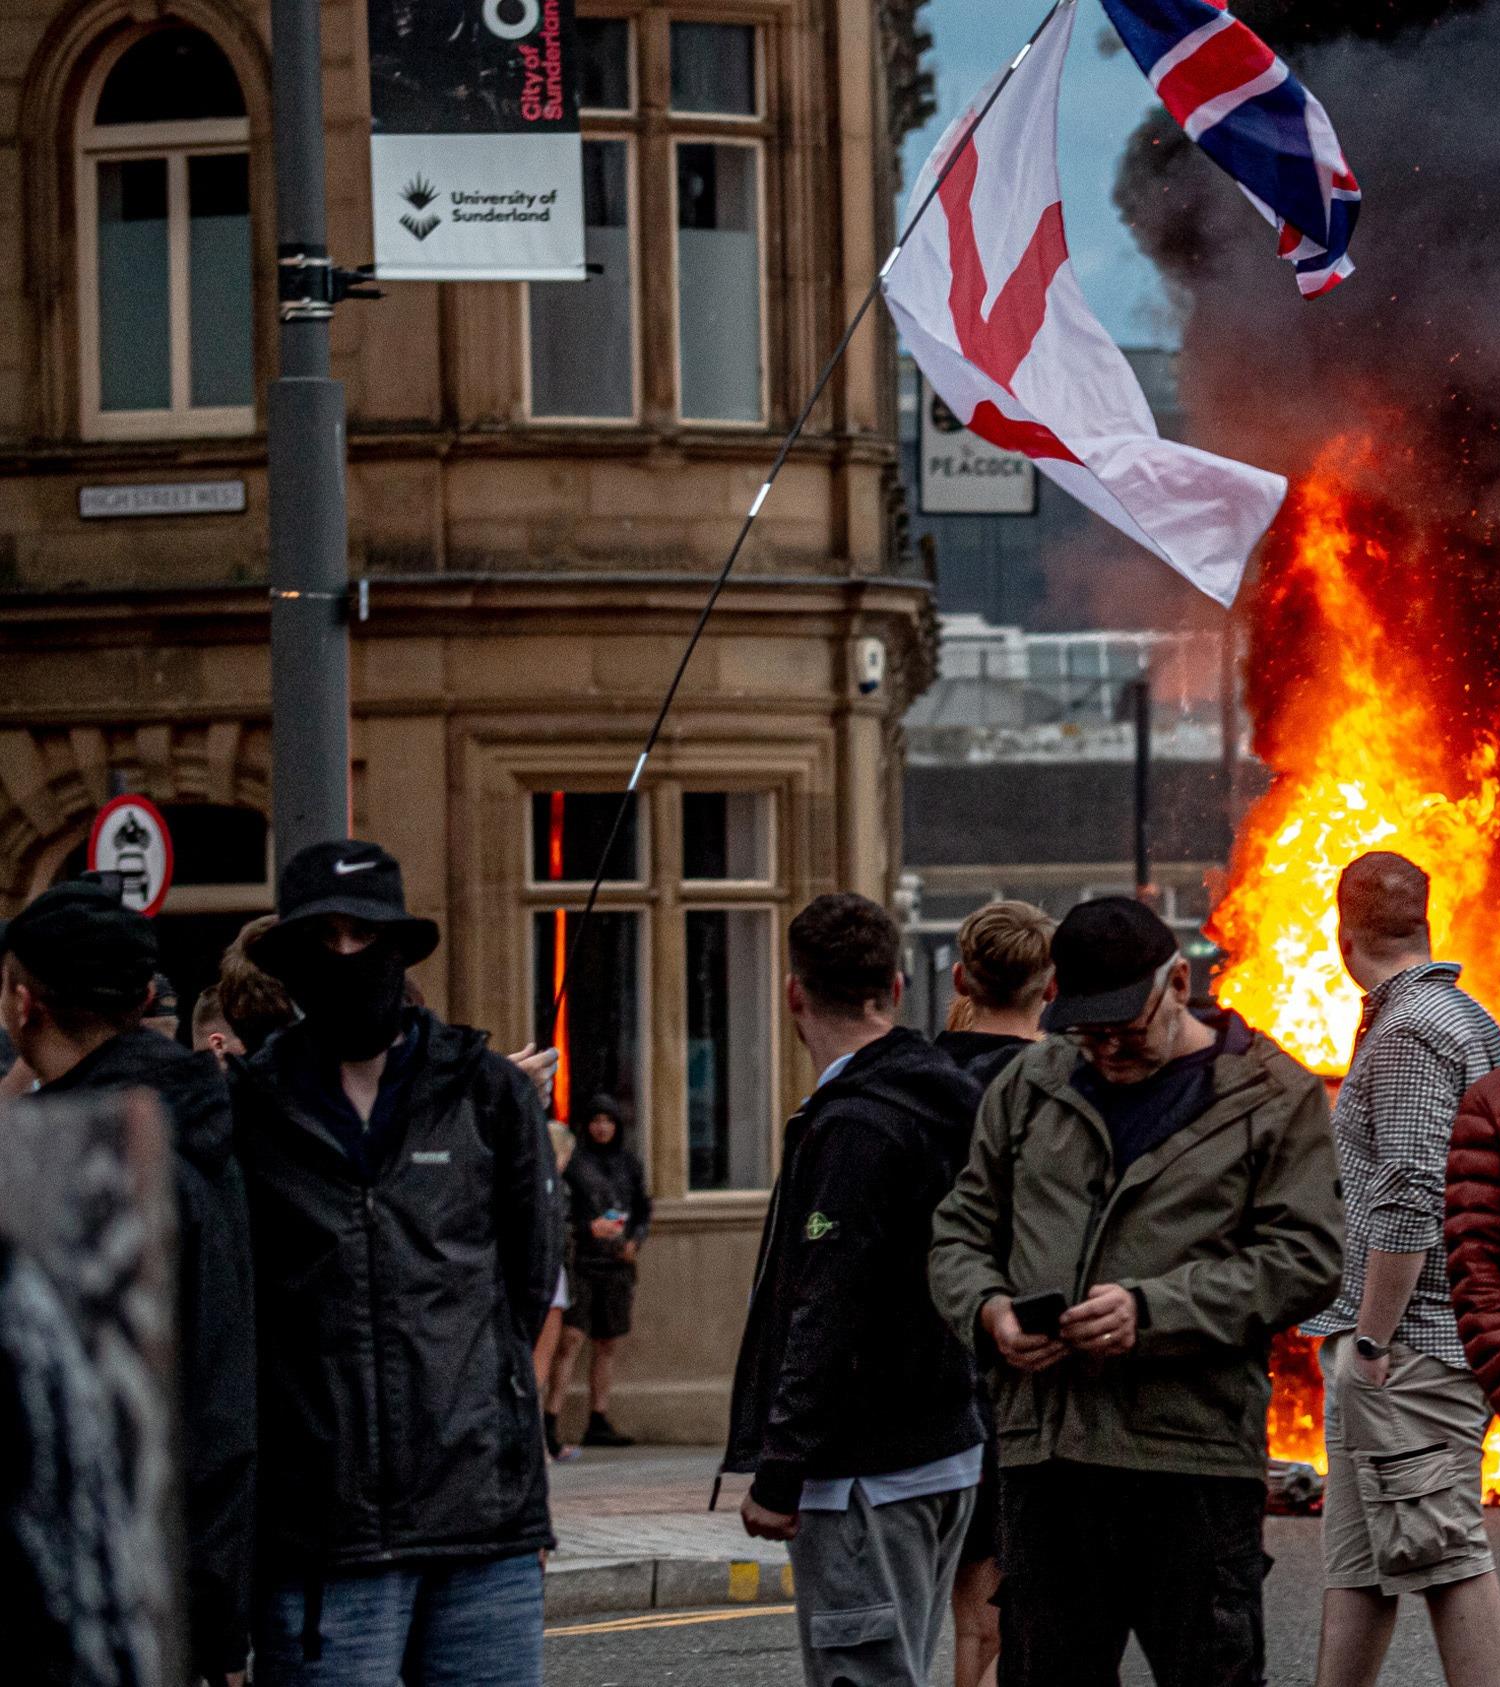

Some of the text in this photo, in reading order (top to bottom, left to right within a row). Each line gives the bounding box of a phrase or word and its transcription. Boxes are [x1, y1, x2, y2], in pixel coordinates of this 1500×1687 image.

[540, 0, 564, 120] Sunderlan
[519, 44, 543, 121] City of
[451, 188, 558, 208] University of
[452, 207, 551, 222] Sunderland
[134, 488, 192, 508] STREET
